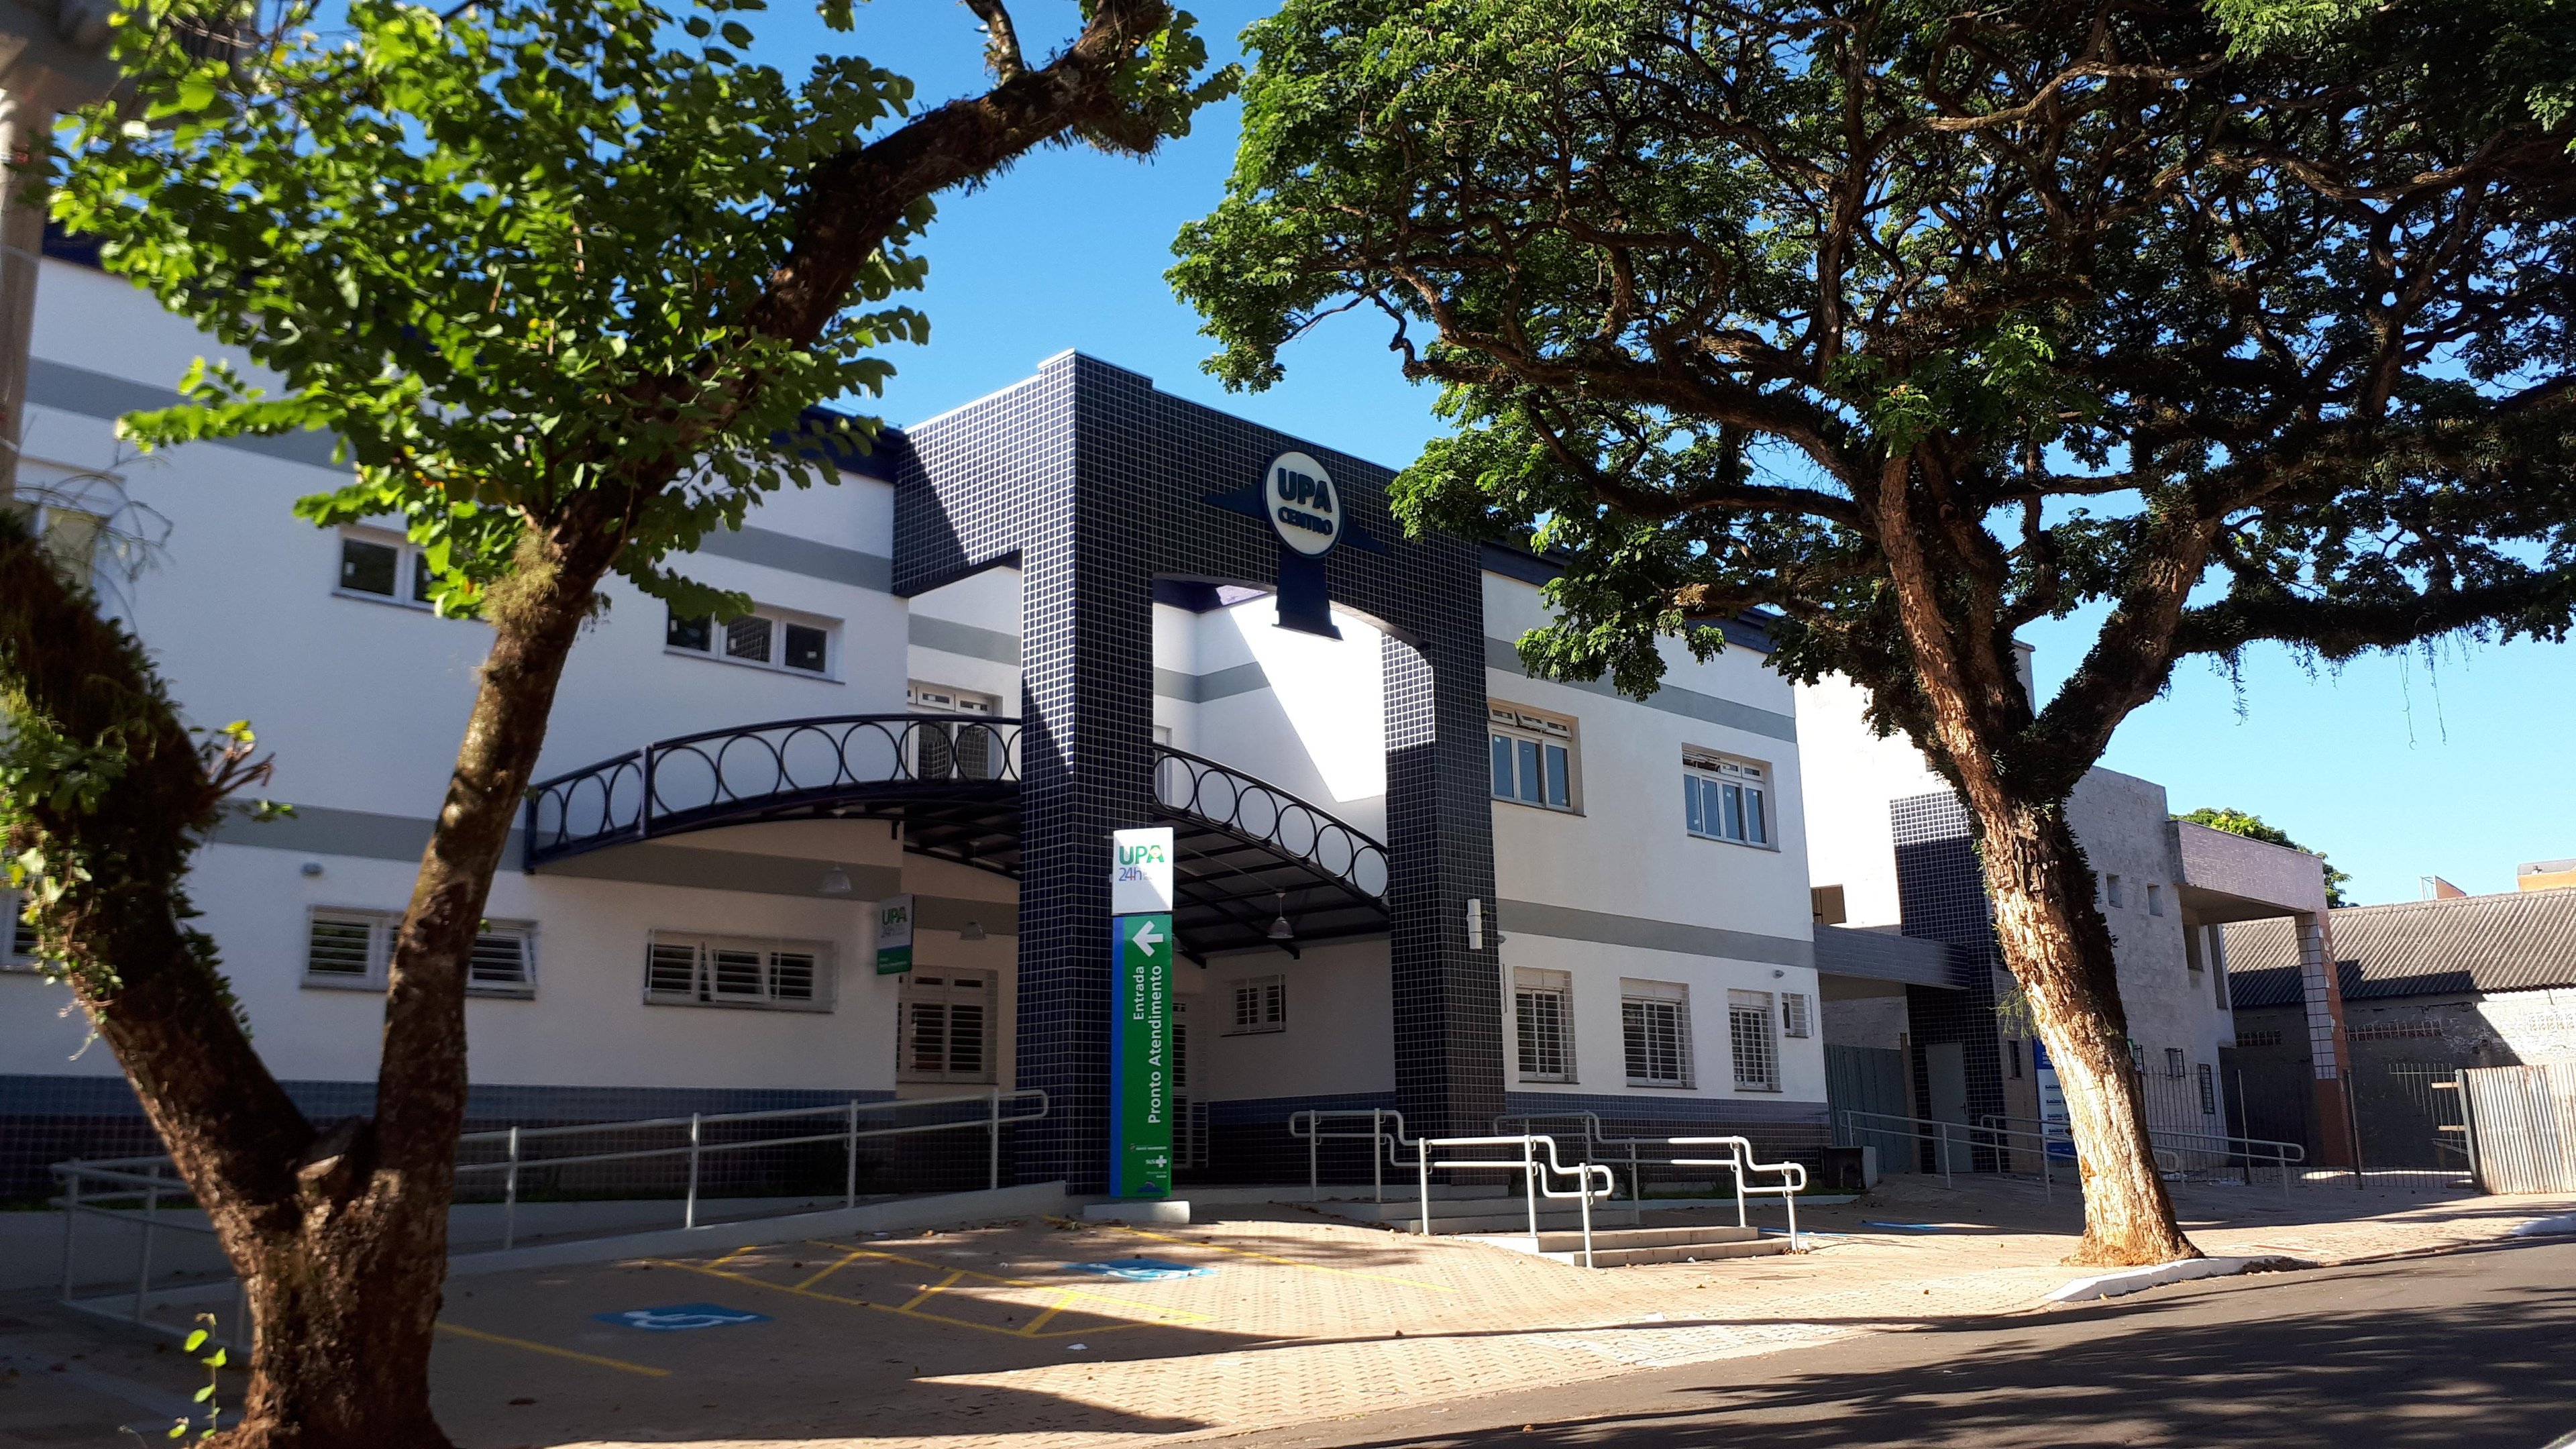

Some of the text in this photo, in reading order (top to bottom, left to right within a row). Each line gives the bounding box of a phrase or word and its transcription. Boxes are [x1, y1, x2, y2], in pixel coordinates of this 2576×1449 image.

[1277, 468, 1332, 513] UPA
[1278, 506, 1333, 535] CENTRO
[1119, 845, 1165, 865] UPA
[1119, 867, 1142, 881] 24h
[882, 906, 908, 926] UPA
[1133, 966, 1144, 1020] Entrada
[1148, 965, 1162, 1124] Pronto Atendimento
